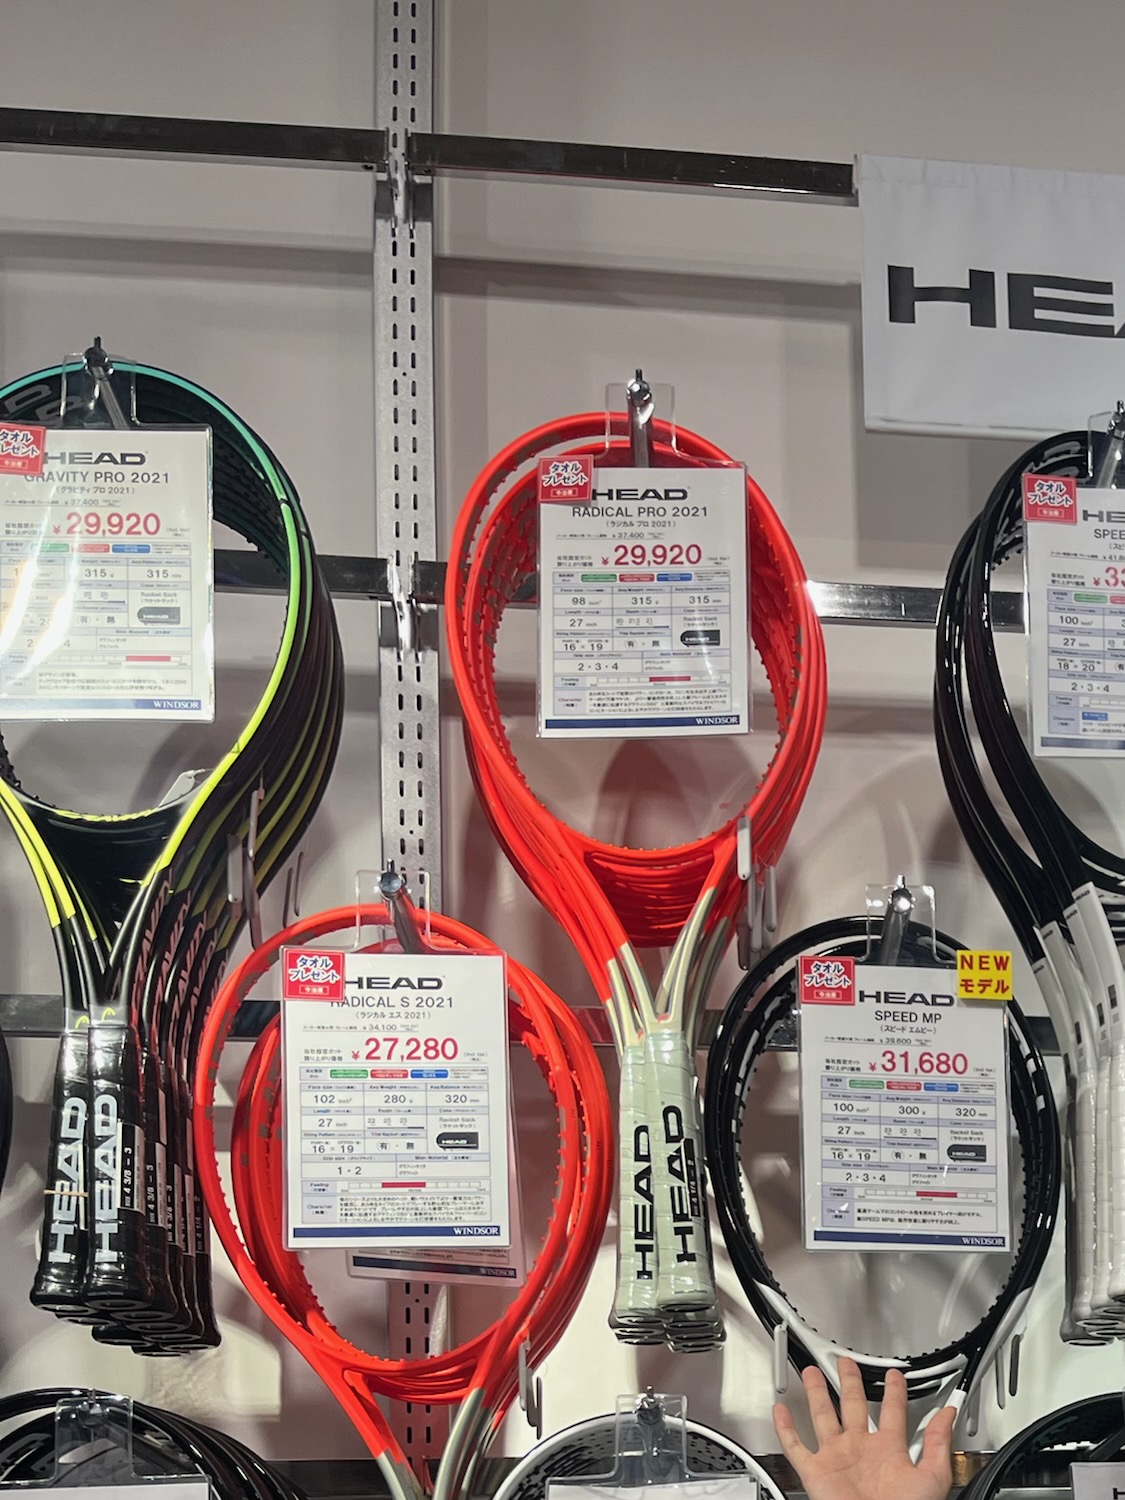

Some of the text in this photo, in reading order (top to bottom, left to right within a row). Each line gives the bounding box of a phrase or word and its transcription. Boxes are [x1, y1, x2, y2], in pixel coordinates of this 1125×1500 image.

[44, 452, 146, 465] HEAD
[552, 463, 580, 473] タオル
[94, 472, 125, 483] PRO
[131, 473, 168, 483] 2021
[543, 474, 587, 486] プレゼント
[1036, 482, 1065, 492] タオル
[592, 488, 688, 500] HEAD
[1030, 494, 1072, 506] プレゼント
[572, 507, 708, 517] RADICAL PRO 2021
[66, 512, 160, 536] 29,920
[614, 544, 702, 566] 29,920
[154, 701, 199, 709] WINDSOR
[696, 717, 738, 725] WINDSOR
[299, 957, 331, 968] タオル
[812, 963, 843, 974] タオル
[961, 955, 1009, 970] NEW
[290, 970, 339, 982] プレゼント
[804, 975, 851, 986] プレゼント
[961, 980, 1009, 994] モデル
[401, 997, 410, 1008] S
[416, 997, 453, 1008] 2021
[859, 991, 955, 1006] HEAD
[875, 1011, 941, 1023] SPEED MP
[365, 1037, 458, 1062] 27,280
[881, 1050, 968, 1075] 31,680
[313, 1095, 335, 1104] 102
[384, 1095, 406, 1104] 280
[445, 1095, 467, 1104] 320
[49, 1097, 87, 1263] HEAD
[94, 1094, 118, 1262] HEAD
[663, 1105, 696, 1262] HEAD
[634, 1125, 654, 1280] HEAD
[453, 1227, 499, 1235] WINDSOR
[962, 1237, 1004, 1246] WINDSOR
